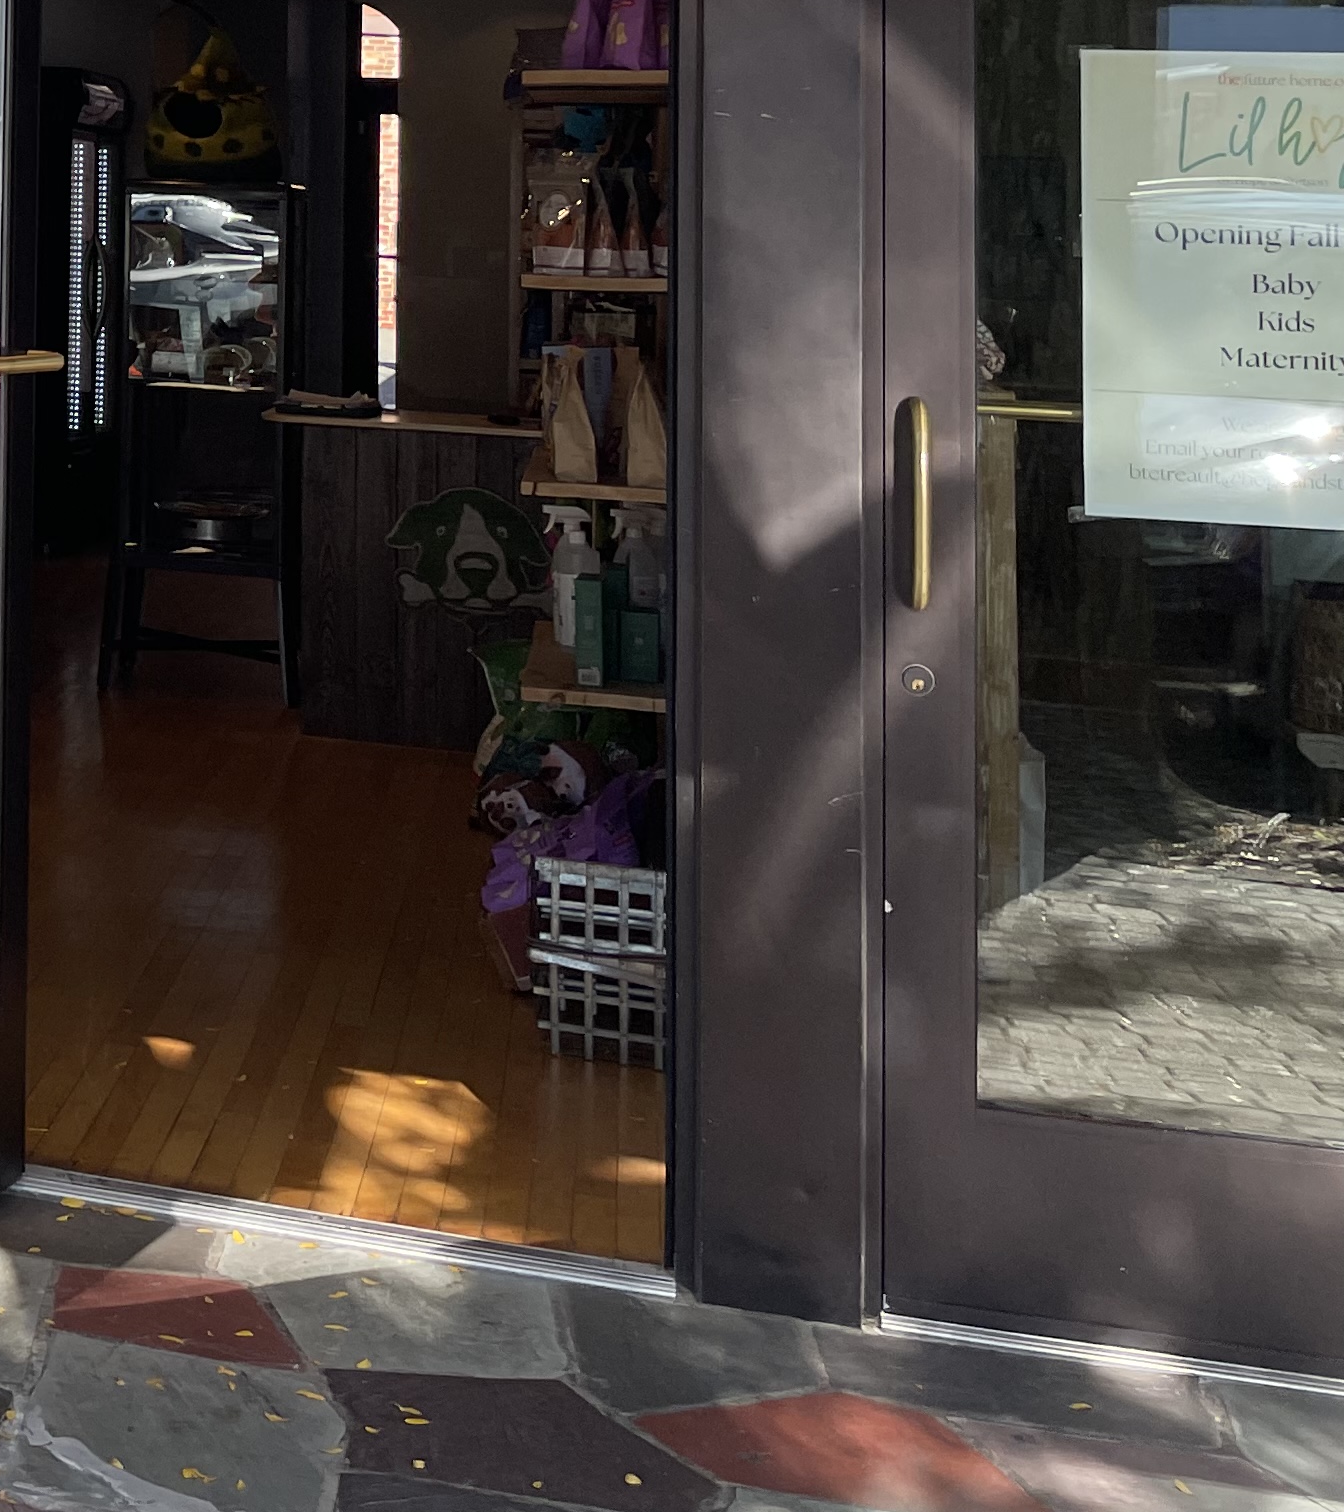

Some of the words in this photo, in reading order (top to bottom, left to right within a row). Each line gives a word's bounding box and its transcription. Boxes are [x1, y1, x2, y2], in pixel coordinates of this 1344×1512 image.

[1289, 73, 1332, 87] home
[1154, 221, 1283, 253] Opening
[1289, 223, 1340, 248] Fall
[1252, 272, 1322, 300] Baby
[1258, 310, 1315, 333] Kids
[1145, 439, 1197, 455] Email
